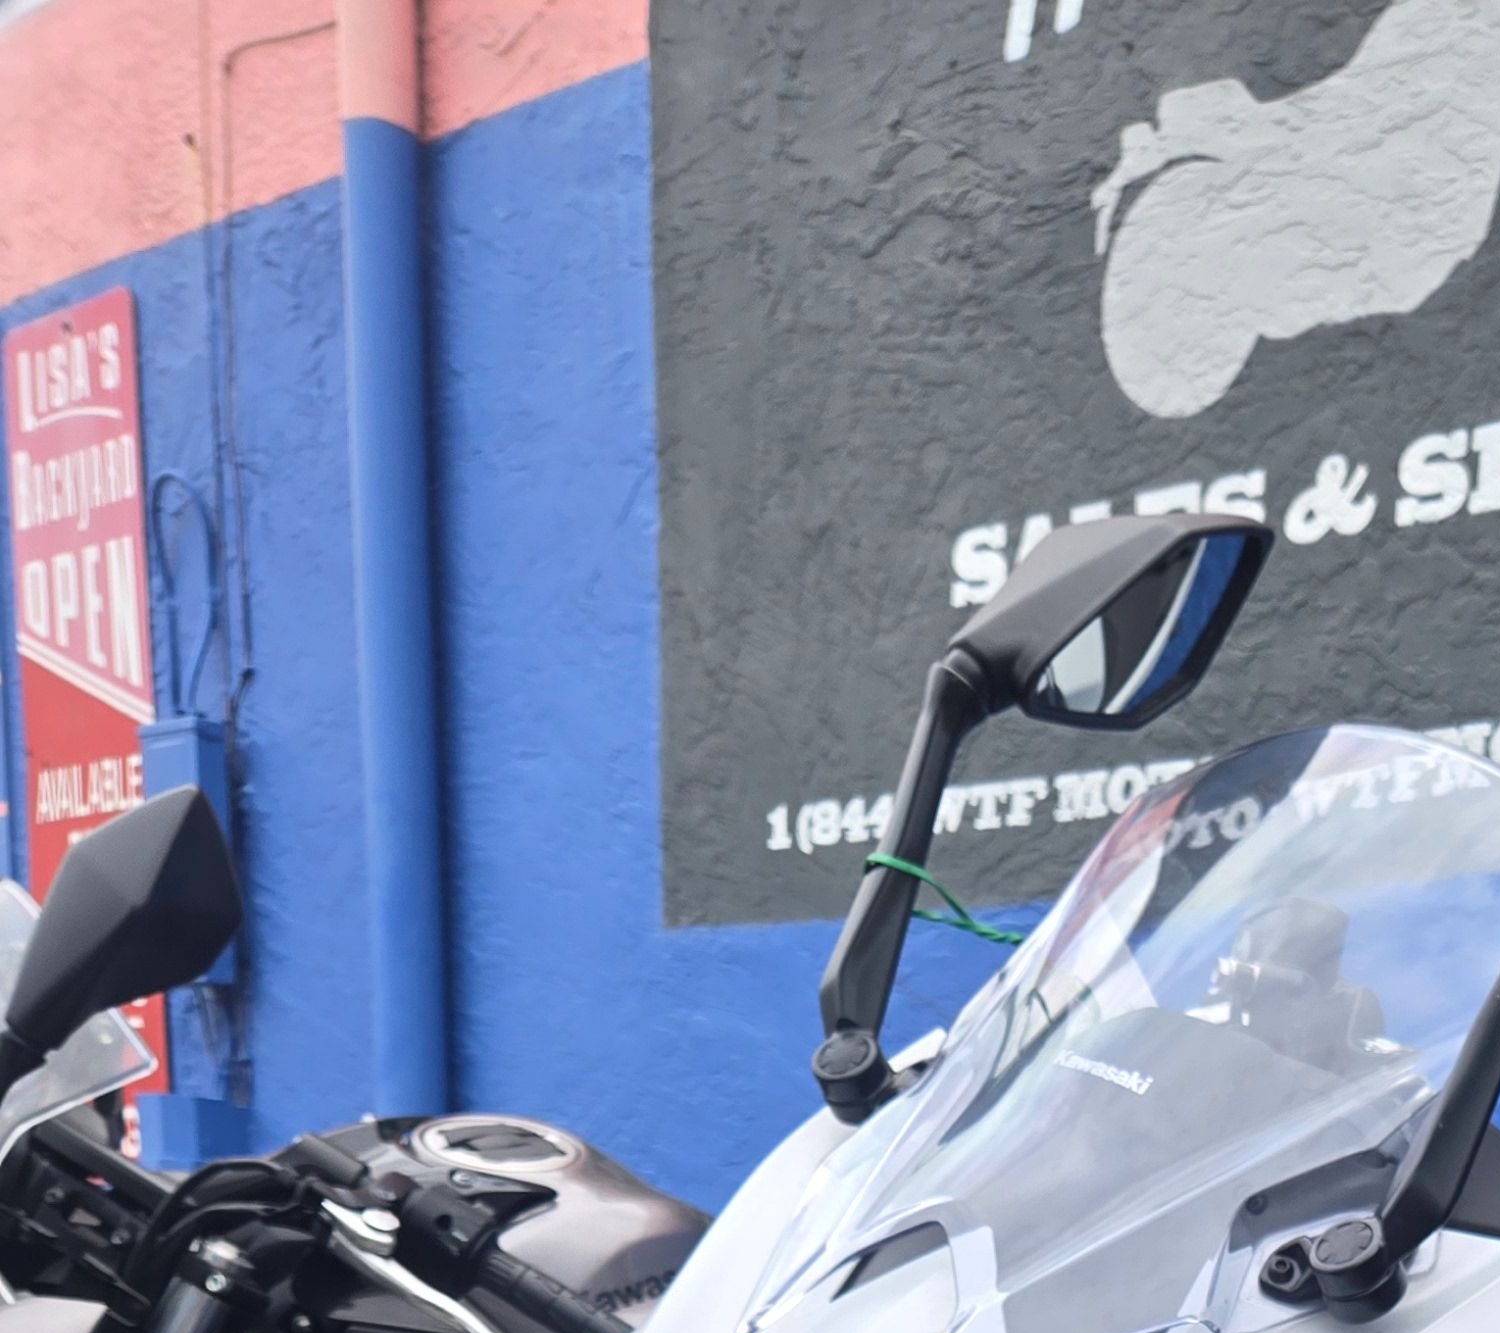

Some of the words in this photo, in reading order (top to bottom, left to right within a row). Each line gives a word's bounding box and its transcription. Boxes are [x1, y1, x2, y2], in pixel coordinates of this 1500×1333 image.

[1284, 454, 1377, 544] &
[23, 535, 143, 688] OPEN
[36, 754, 144, 823] AVAILABLE
[1055, 1050, 1154, 1095] Kawasaki
